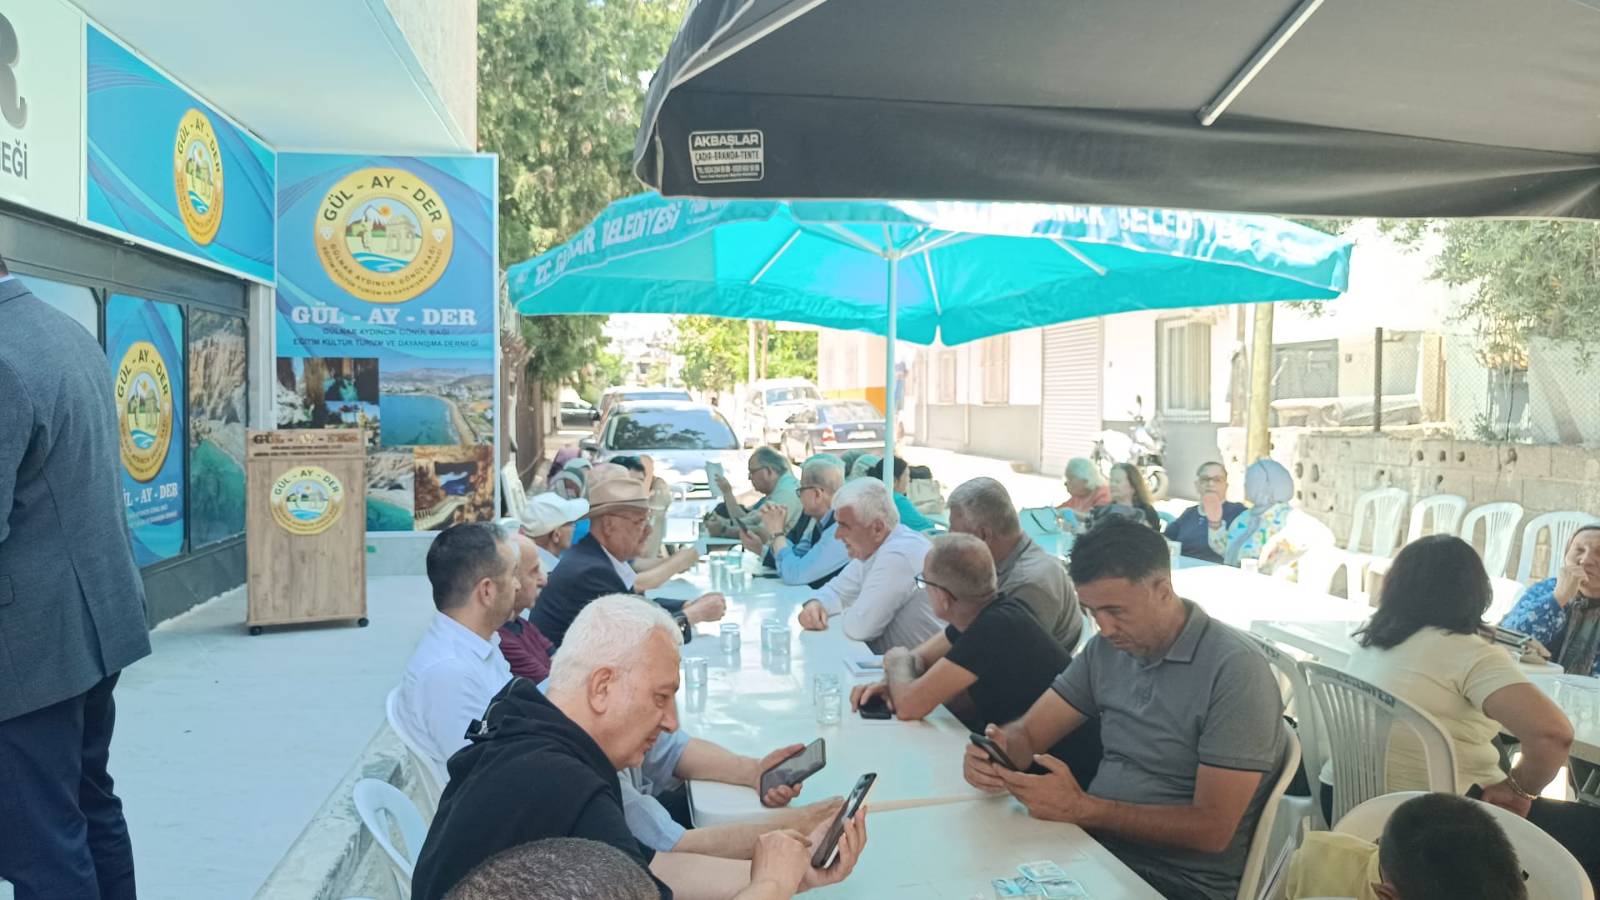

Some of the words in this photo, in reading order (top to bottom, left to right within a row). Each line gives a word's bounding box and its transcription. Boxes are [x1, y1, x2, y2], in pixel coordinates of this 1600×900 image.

[694, 133, 759, 148] AKBAŞLAR
[323, 190, 355, 222] GÜL
[371, 175, 395, 189] AY
[412, 188, 443, 223] DER
[291, 301, 344, 325] GÜL
[367, 308, 400, 325] AY
[421, 308, 477, 326] DER
[138, 349, 149, 364] AY
[155, 364, 169, 396] DER
